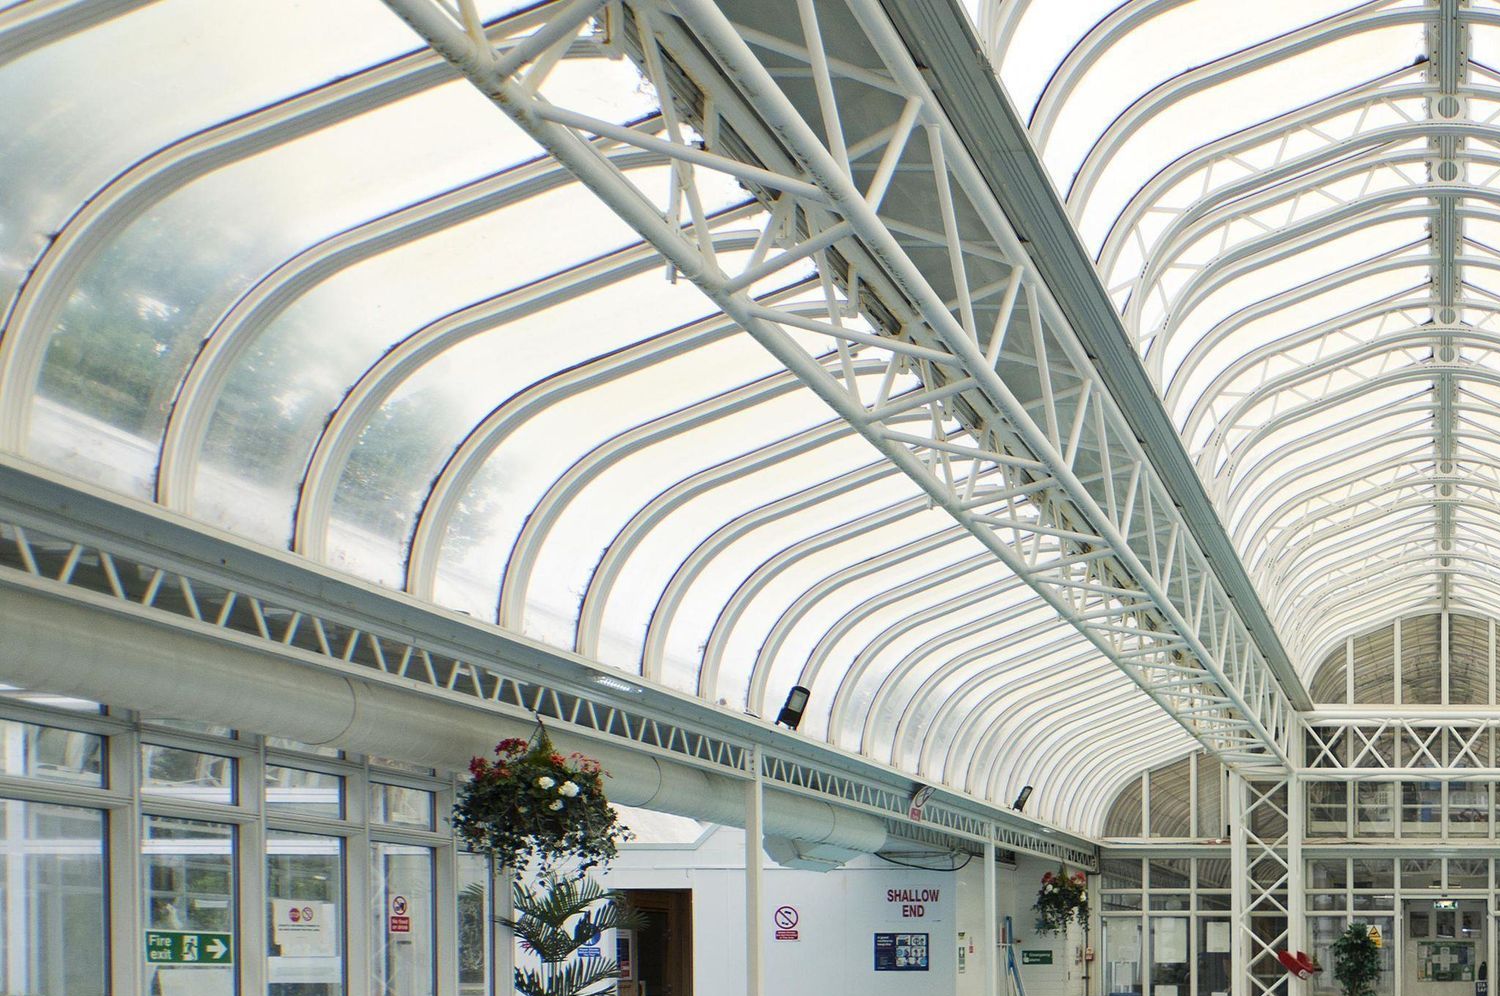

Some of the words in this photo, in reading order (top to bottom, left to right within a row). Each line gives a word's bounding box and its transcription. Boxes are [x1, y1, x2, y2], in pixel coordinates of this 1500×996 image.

[887, 889, 940, 902] SHALLOW
[902, 905, 925, 917] END
[149, 934, 172, 946] Fire
[151, 948, 172, 960] exit
